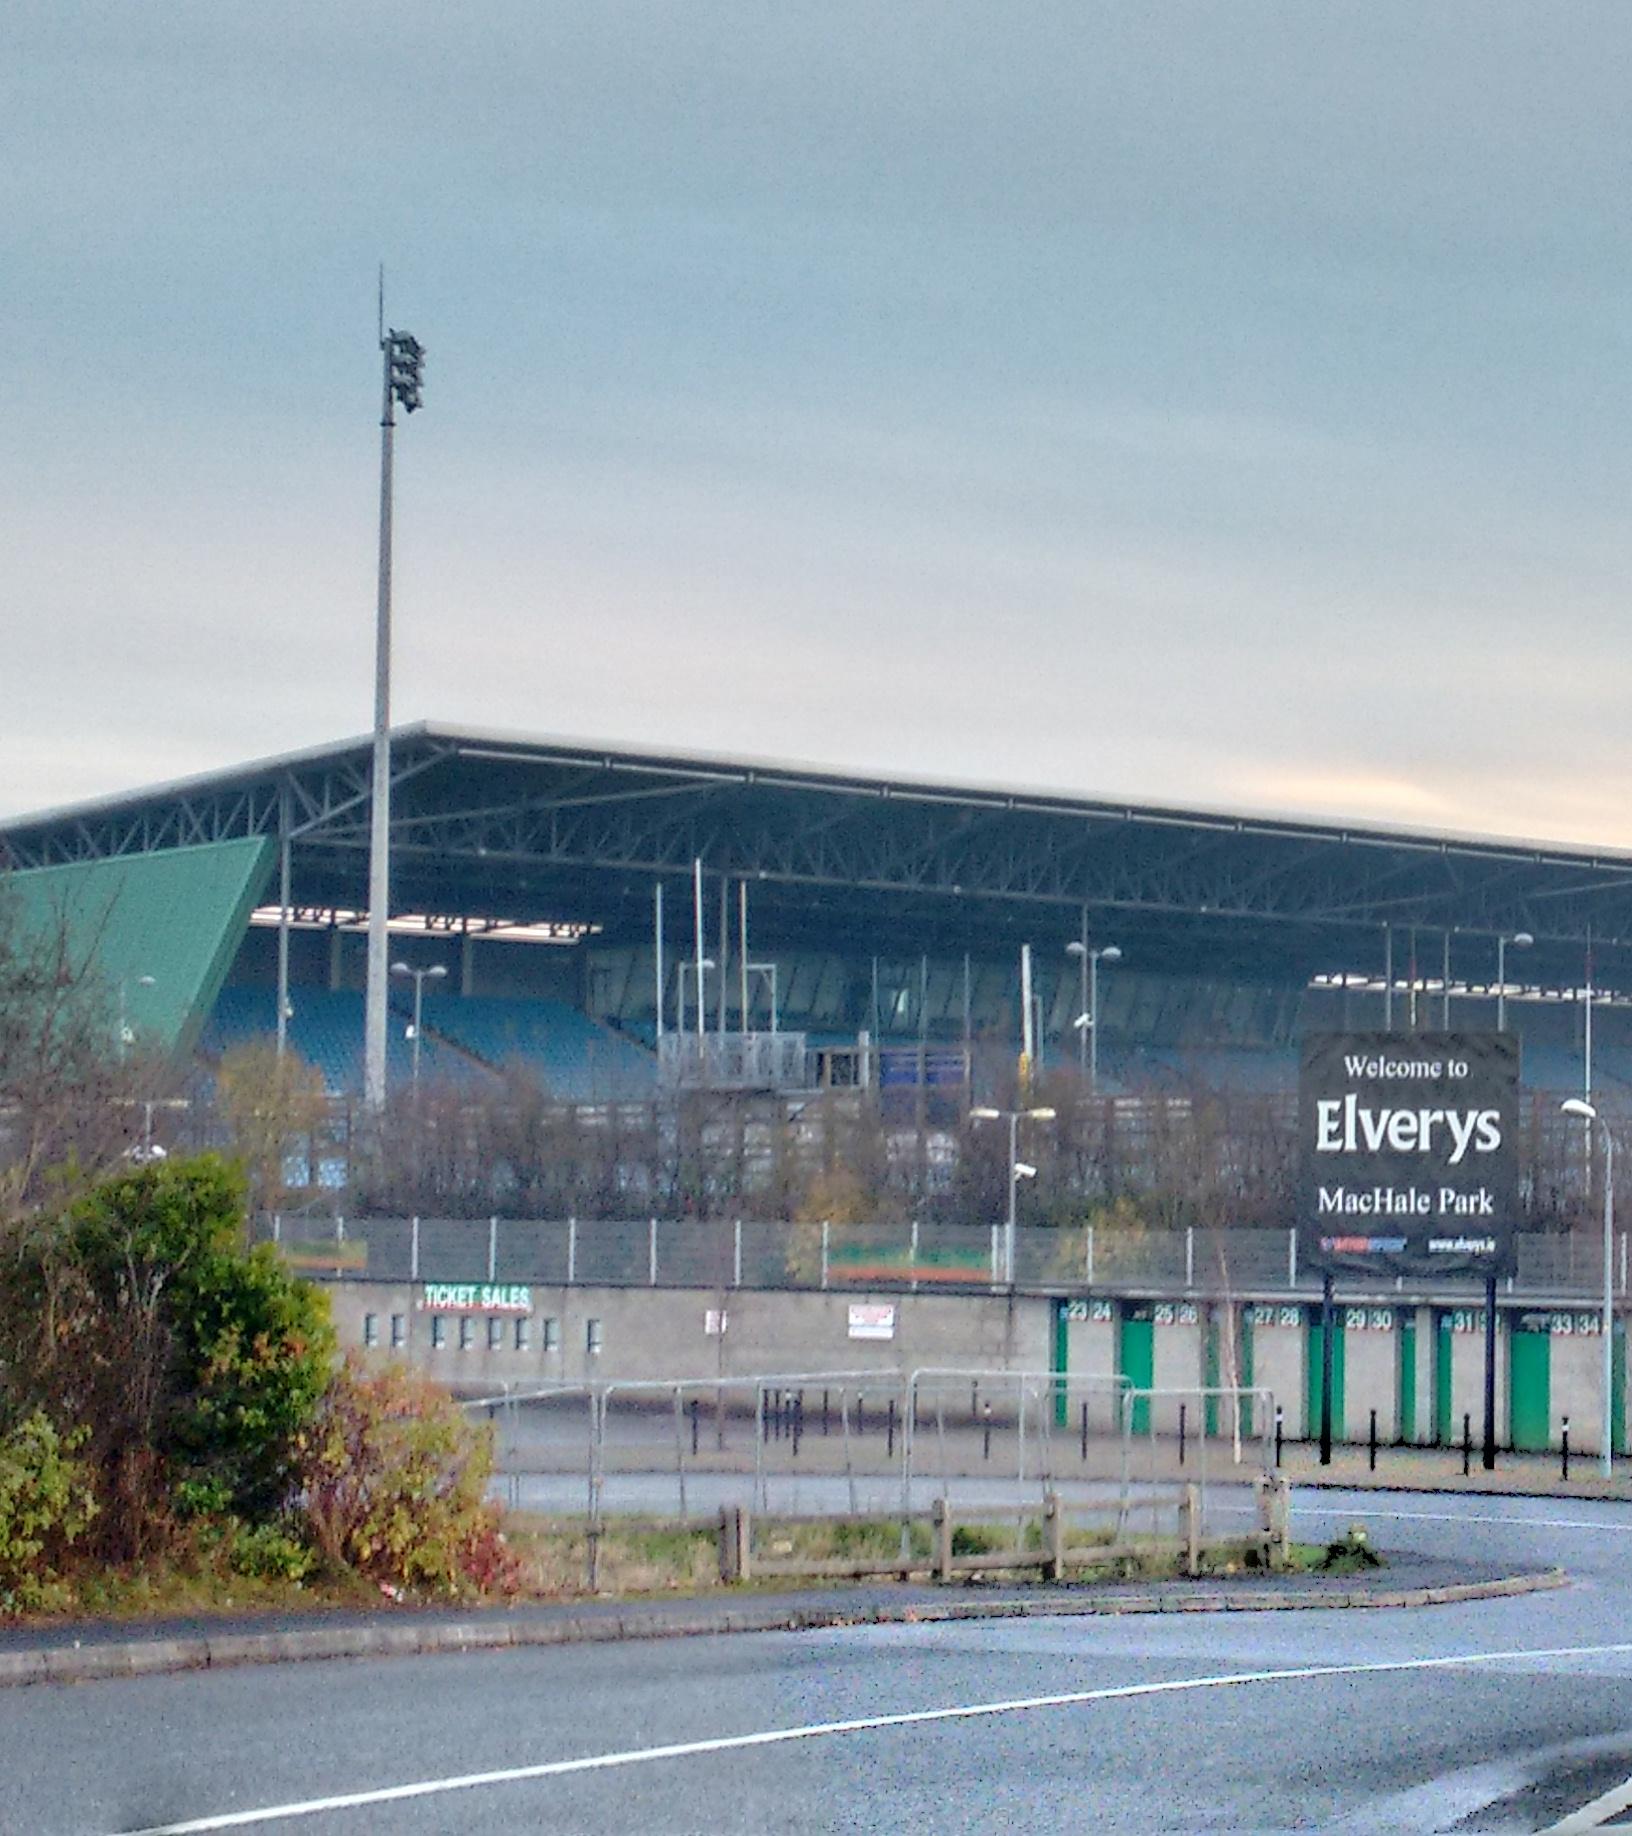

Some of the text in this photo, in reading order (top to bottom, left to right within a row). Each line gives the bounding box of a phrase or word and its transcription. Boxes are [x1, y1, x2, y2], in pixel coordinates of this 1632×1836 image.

[1344, 1056, 1468, 1078] Welcome to
[1317, 1093, 1501, 1164] Elverys
[1318, 1187, 1494, 1214] MacHale Park
[425, 1285, 531, 1310] TICKET SALES
[1069, 1301, 1087, 1320] 23
[1093, 1302, 1112, 1321] 24
[1254, 1307, 1274, 1326] 27
[1280, 1307, 1299, 1326] 28
[1347, 1309, 1366, 1328] 29
[1373, 1310, 1392, 1330] 30
[1454, 1311, 1473, 1332] 31
[1551, 1313, 1572, 1334] 33
[1579, 1314, 1599, 1336] 34
